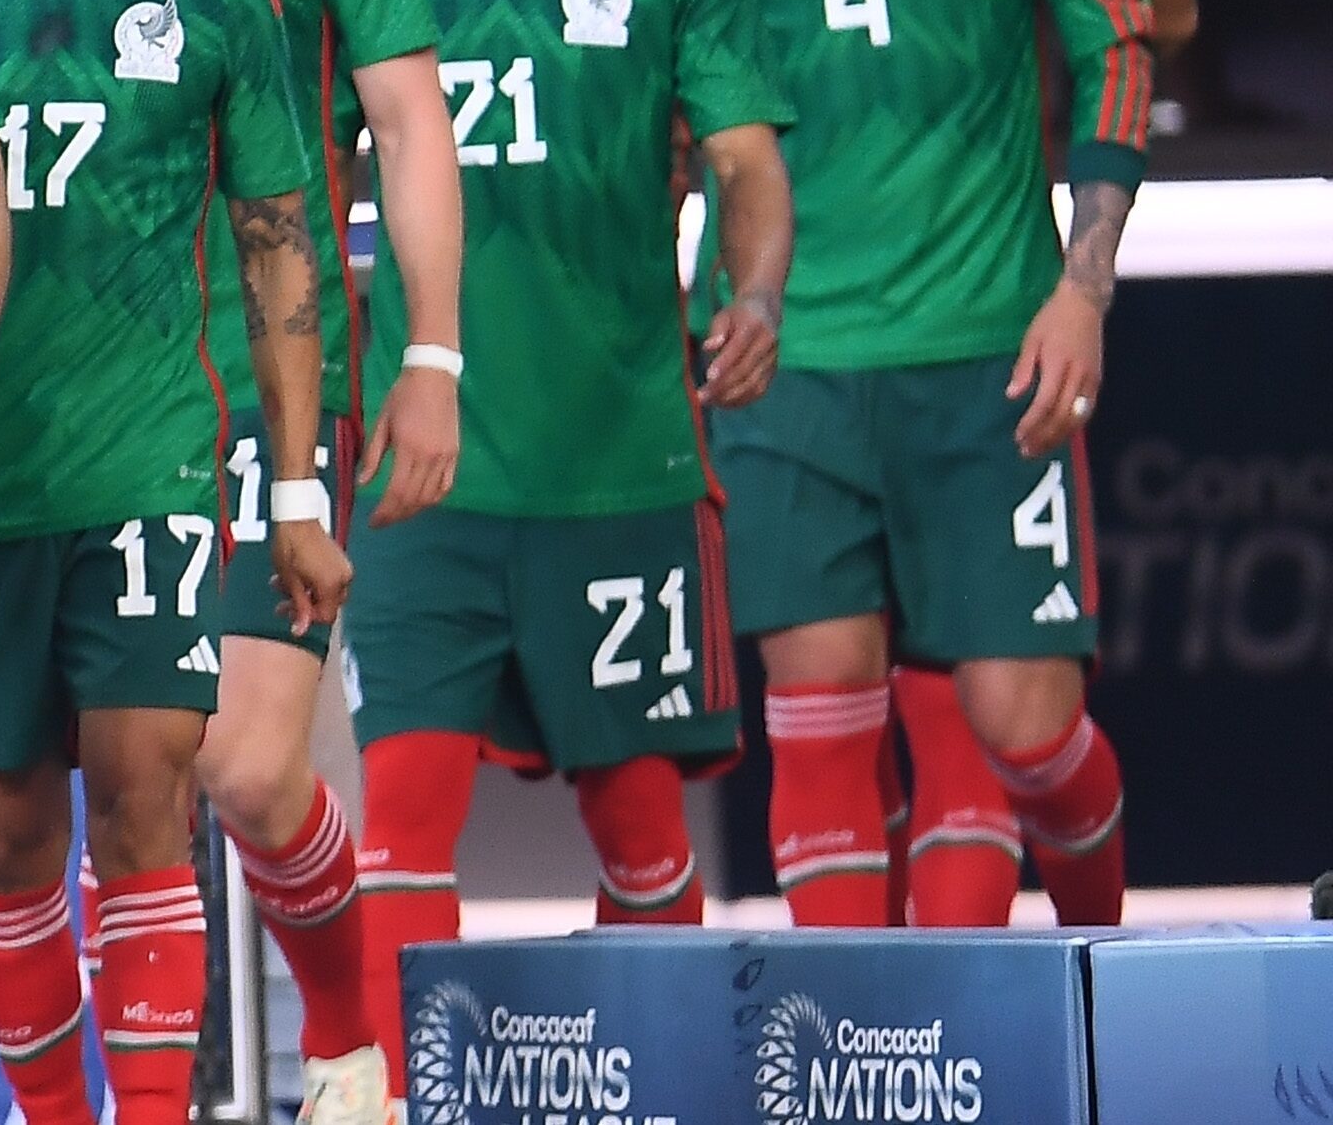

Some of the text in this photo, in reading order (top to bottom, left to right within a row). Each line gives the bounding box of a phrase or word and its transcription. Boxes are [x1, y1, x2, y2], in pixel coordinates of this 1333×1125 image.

[437, 57, 547, 166] 21
[1013, 461, 1070, 567] 4
[109, 513, 215, 617] 17
[587, 567, 692, 687] 21
[491, 1006, 596, 1043] Concacaf
[837, 1018, 942, 1054] Concacaf
[463, 1044, 632, 1111] NATIONS
[807, 1057, 982, 1122] NATIONS
